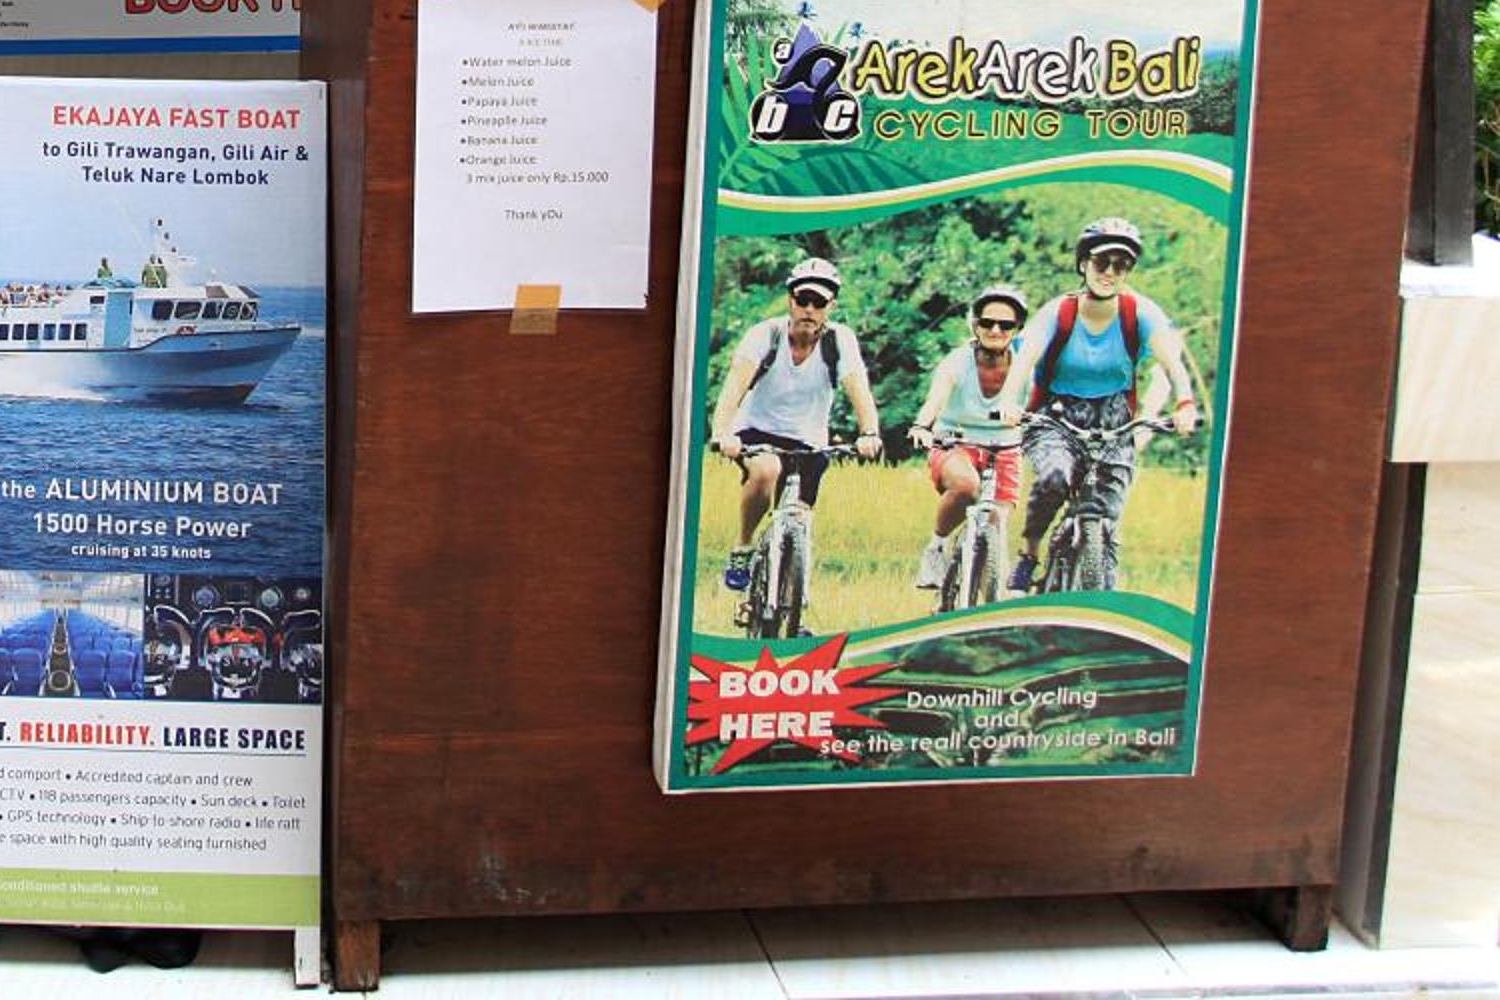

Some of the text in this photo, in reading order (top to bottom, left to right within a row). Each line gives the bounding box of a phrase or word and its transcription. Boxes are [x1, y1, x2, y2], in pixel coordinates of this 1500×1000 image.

[469, 58, 503, 66] Water
[852, 35, 1200, 98] ArekArek Bali
[54, 106, 300, 130] EKAJAYA FAST BOAT
[874, 109, 1188, 139] CYCLING TOUR
[43, 142, 308, 165] to Gili Trawangan, Gili Air &
[83, 166, 269, 186] Teluk Nare Lombok
[527, 174, 550, 184] only
[505, 210, 538, 220] Thank
[1, 478, 282, 505] the ALUMINIUM BOAT
[33, 513, 251, 538] 1500 Horse Power
[71, 543, 211, 559] cruising at 35 knots
[719, 669, 840, 698] BOOK
[907, 687, 1098, 709] Downhill Cycling
[720, 711, 835, 743] HERE
[974, 711, 1019, 729] and
[20, 724, 156, 747] RELIABILITY.
[163, 727, 229, 749] LARGE
[238, 729, 306, 751] SPACE
[820, 739, 863, 754] see
[868, 735, 903, 752] the
[968, 729, 1101, 750] countryside
[1108, 727, 1127, 746] in
[1135, 728, 1176, 746] Bali
[75, 771, 143, 784] Accredited
[196, 774, 219, 786] and
[223, 776, 253, 787] crew
